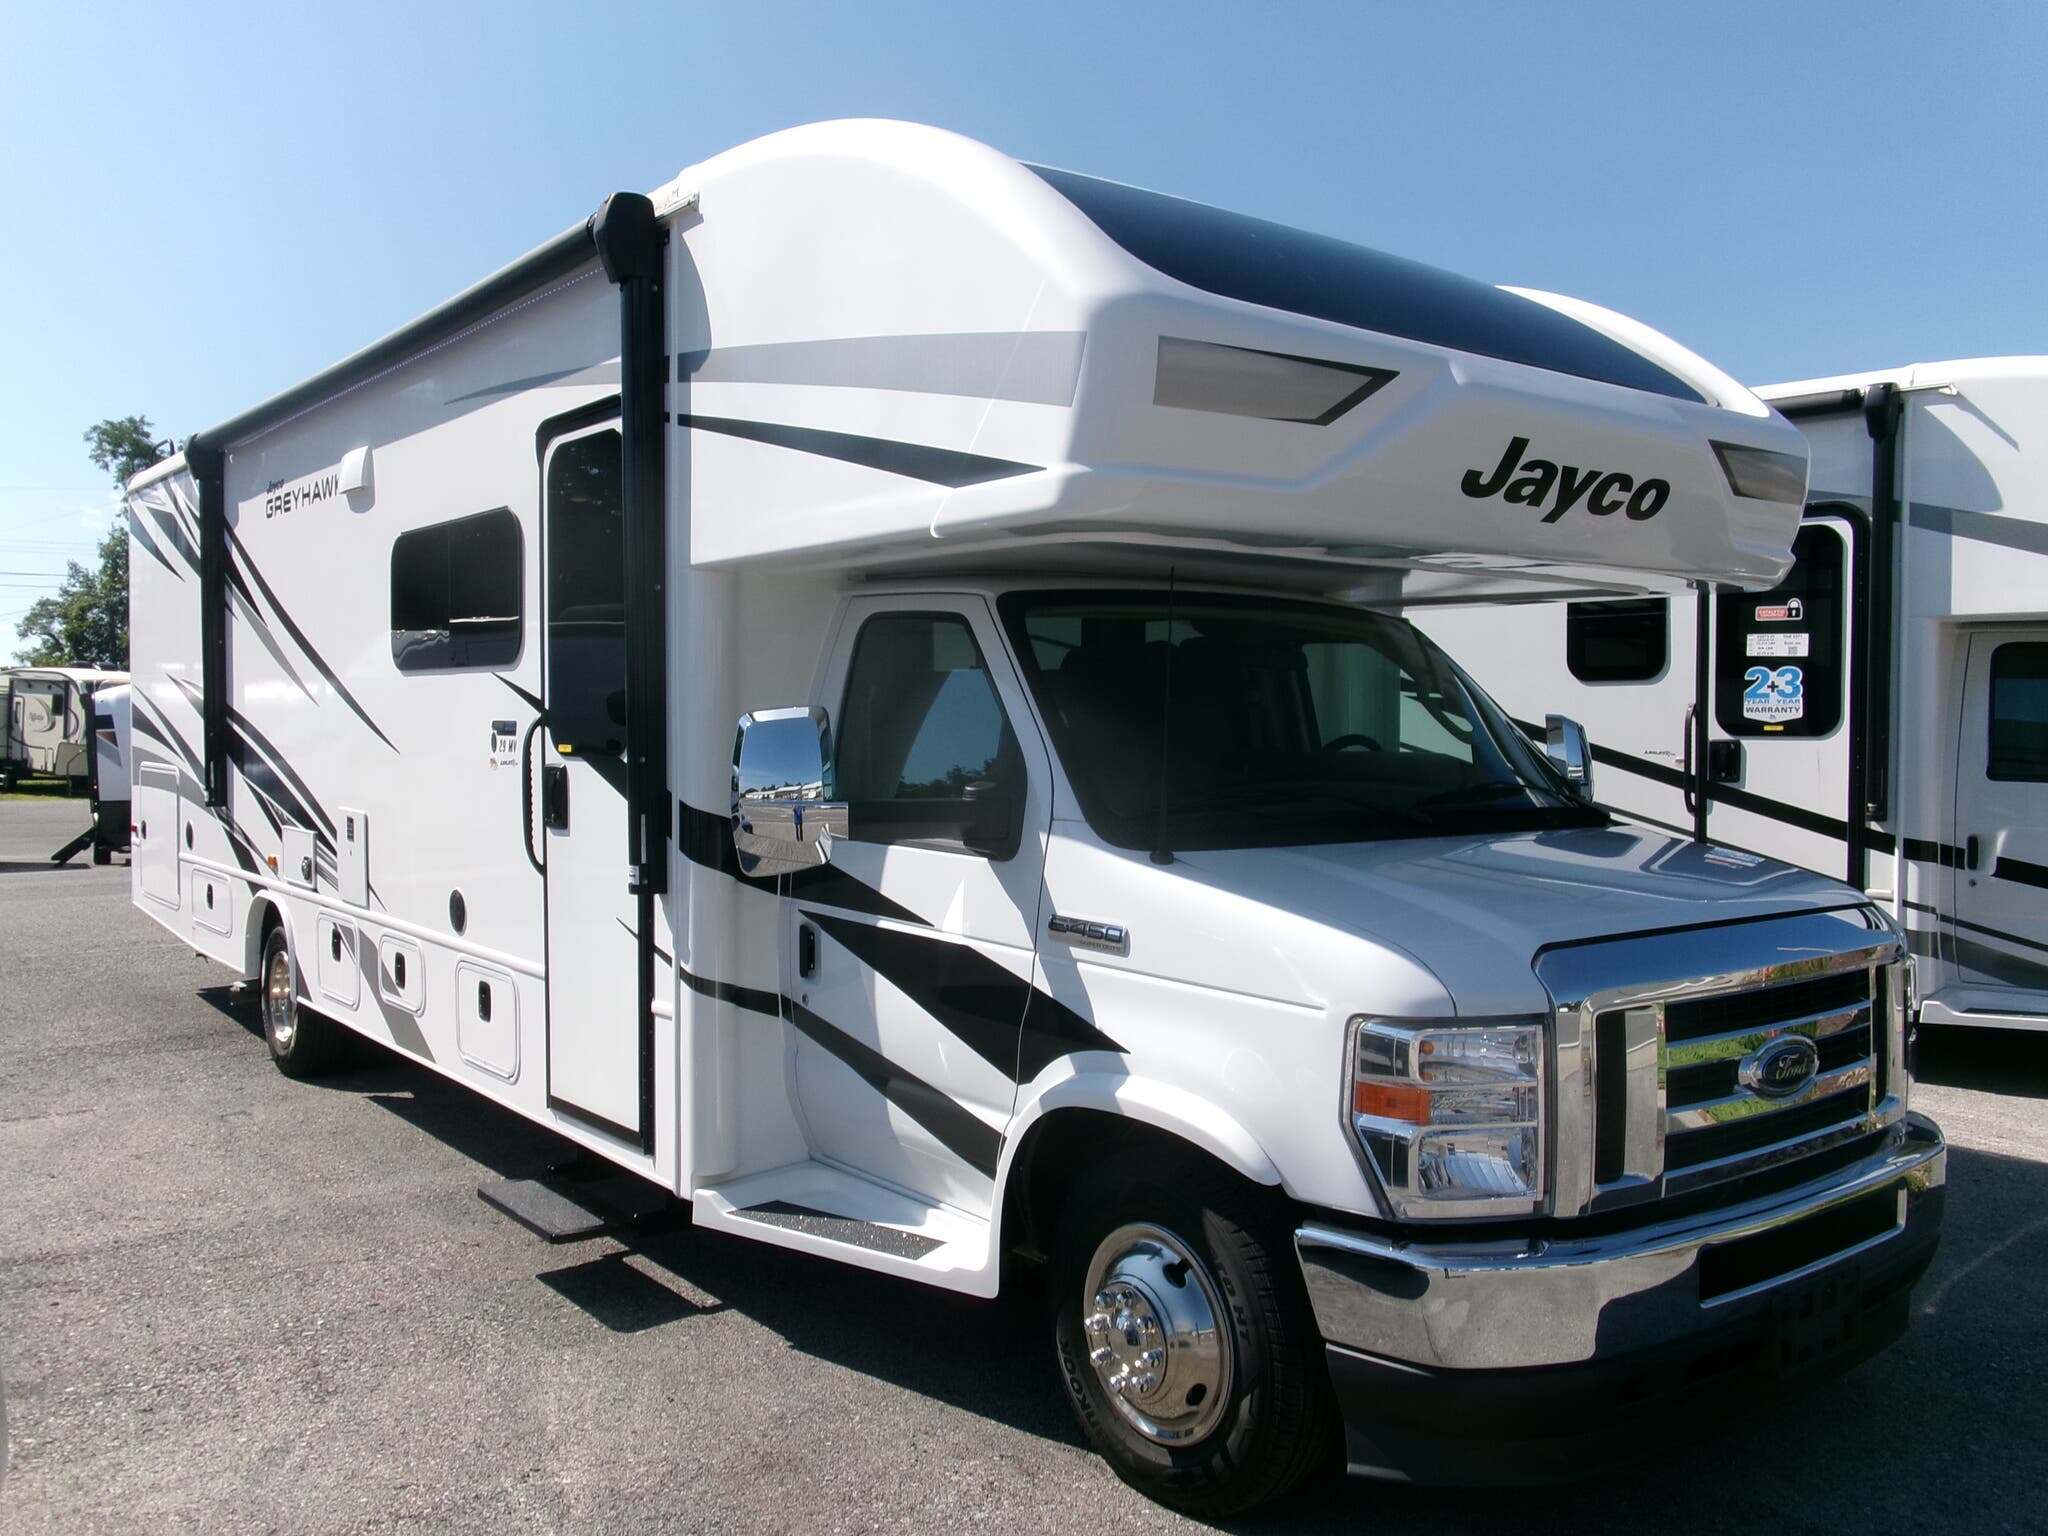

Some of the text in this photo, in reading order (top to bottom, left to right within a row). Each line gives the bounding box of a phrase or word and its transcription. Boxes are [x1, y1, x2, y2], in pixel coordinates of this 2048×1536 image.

[1461, 436, 1671, 523] Jayco
[1745, 706, 1801, 714] WARRANTY
[1776, 1053, 1808, 1080] Ford
